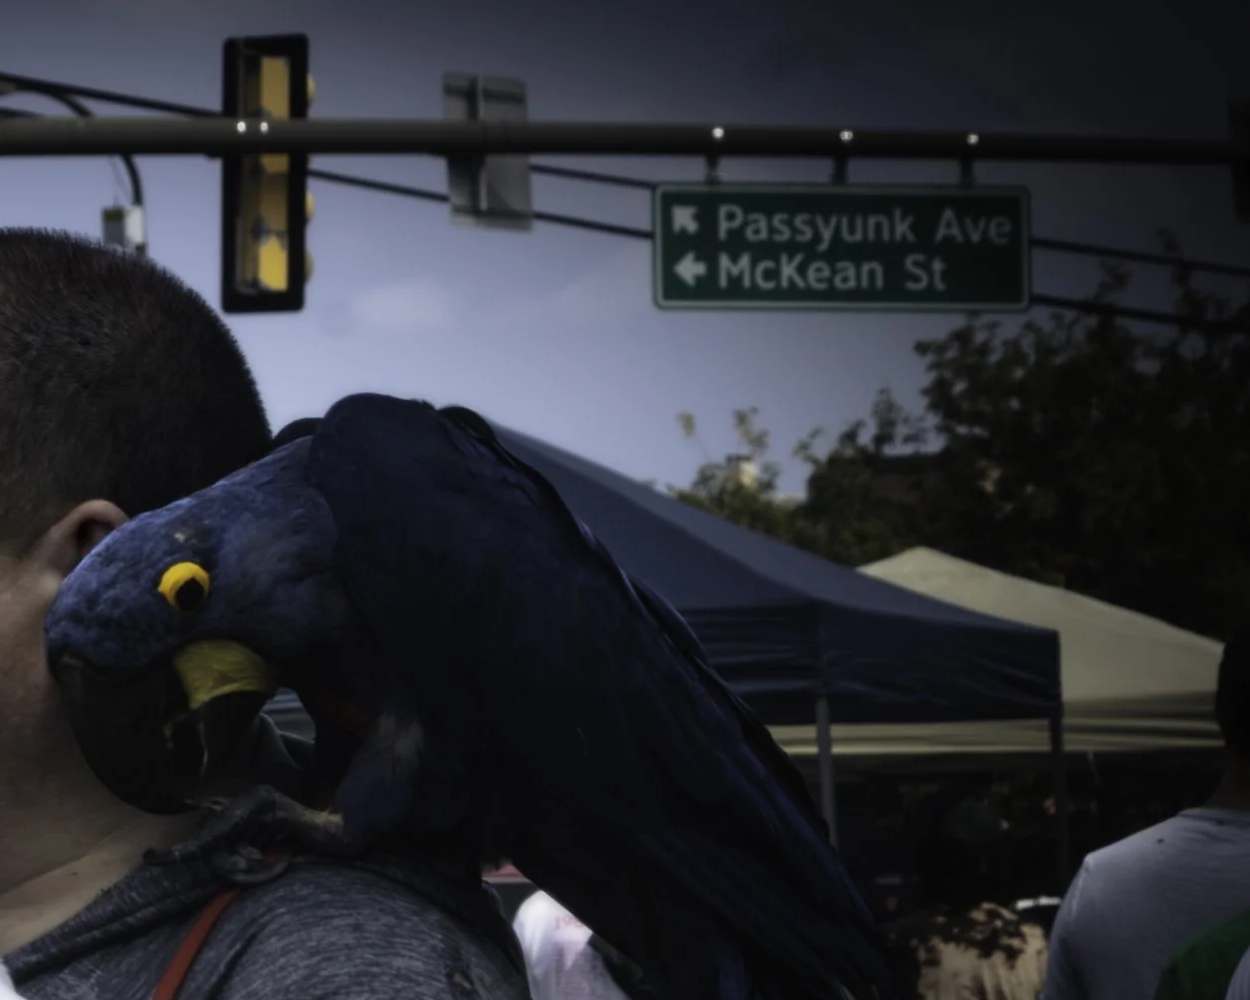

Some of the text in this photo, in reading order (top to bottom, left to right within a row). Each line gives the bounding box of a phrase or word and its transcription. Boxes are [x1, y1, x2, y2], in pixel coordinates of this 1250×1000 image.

[717, 203, 1012, 252] Passyunk Ave
[718, 250, 948, 291] McKean St
